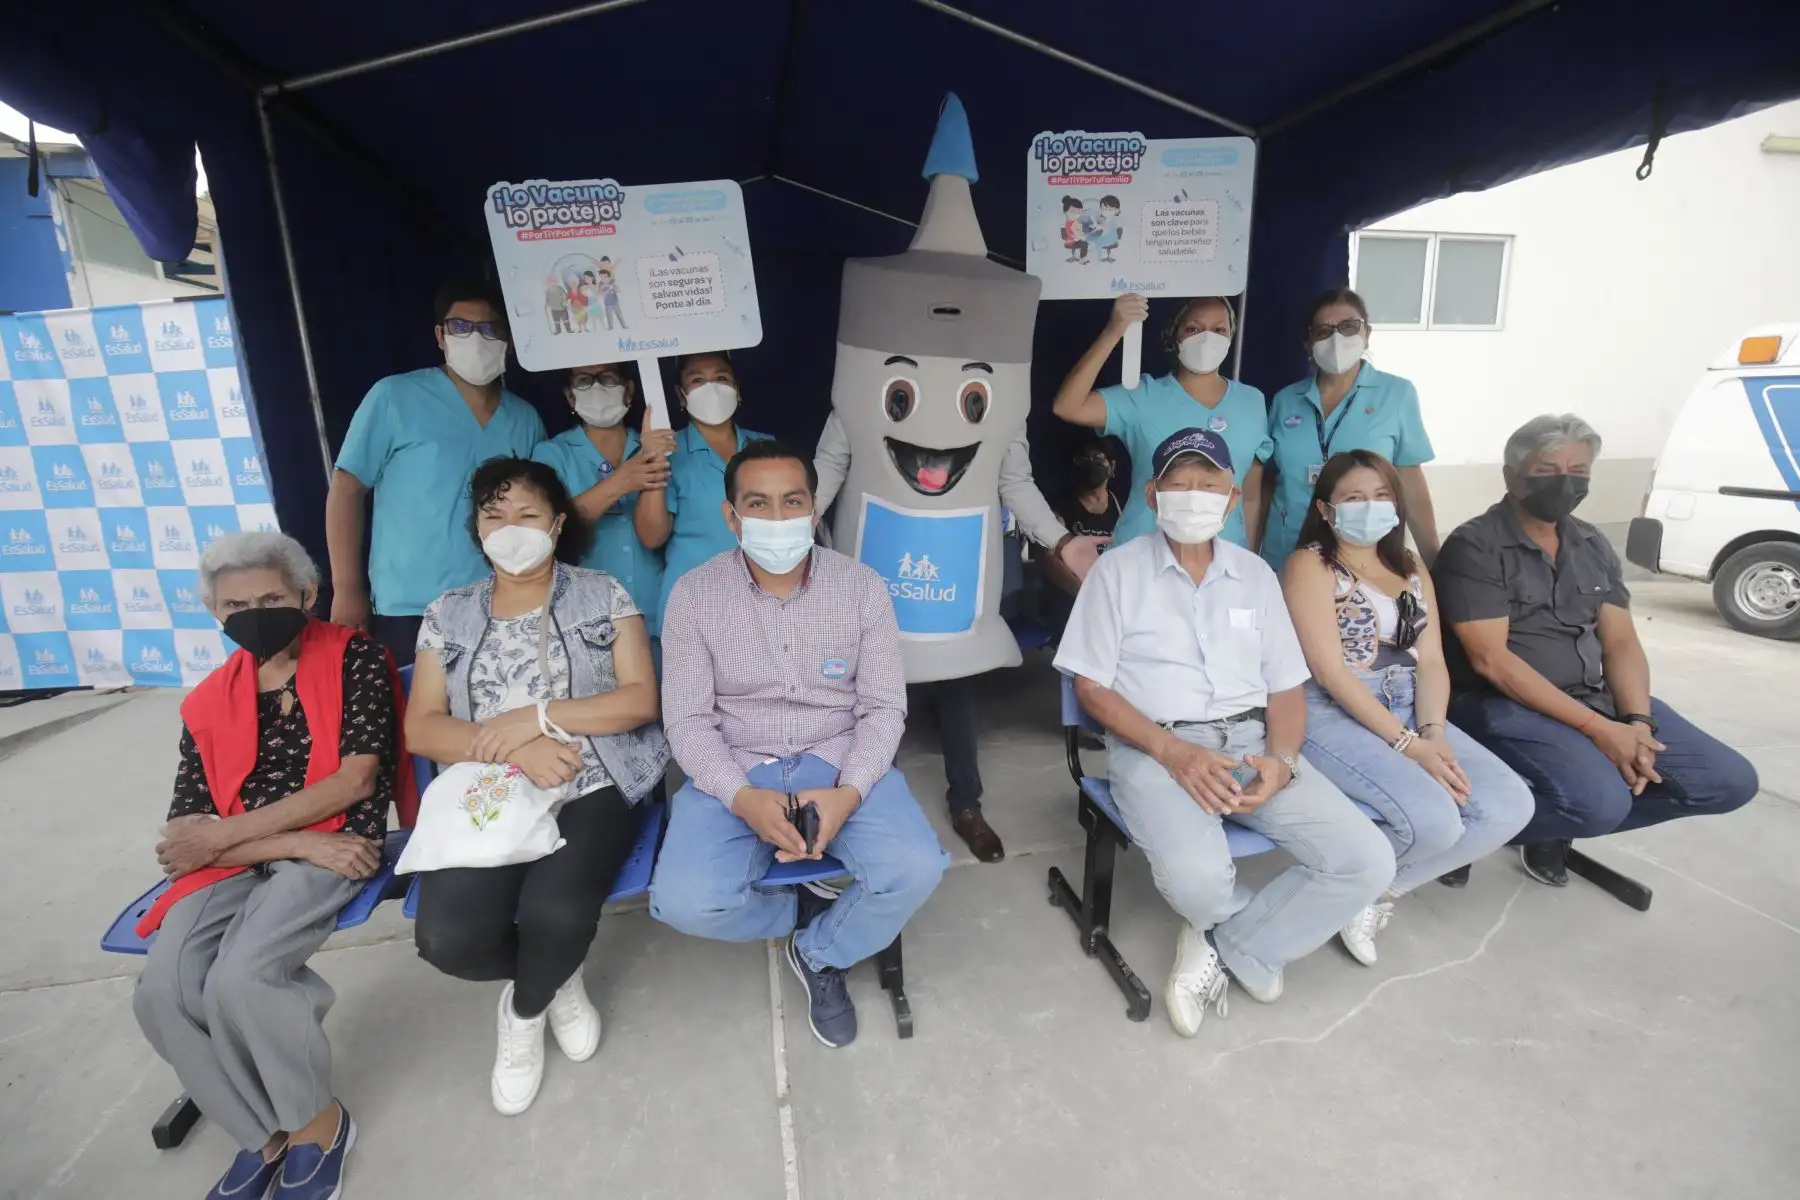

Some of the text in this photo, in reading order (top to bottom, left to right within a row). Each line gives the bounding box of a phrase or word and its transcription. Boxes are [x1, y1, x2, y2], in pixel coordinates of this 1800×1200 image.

[1035, 136, 1147, 160] ¡Lo Vacuno,
[1041, 153, 1063, 173] lo
[1062, 152, 1141, 176] protejo!
[493, 186, 530, 213] ¡Lo
[527, 184, 625, 208] Vacuno,
[505, 204, 530, 228] lo
[530, 200, 621, 229] protejo!
[1155, 209, 1206, 217] Las vacunas
[1167, 218, 1189, 226] clave
[1189, 219, 1209, 228] para
[1145, 238, 1173, 248] tengan
[669, 265, 710, 276] vacunas
[648, 276, 713, 289] son seguras y
[652, 286, 713, 300] salvan vidas!
[655, 300, 684, 311] Ponte
[685, 299, 694, 308] al
[207, 335, 233, 348] EsSa
[221, 406, 246, 418] EsSa
[0, 480, 32, 493] Salud
[236, 475, 264, 486] EsSal
[881, 576, 957, 602] sSalud
